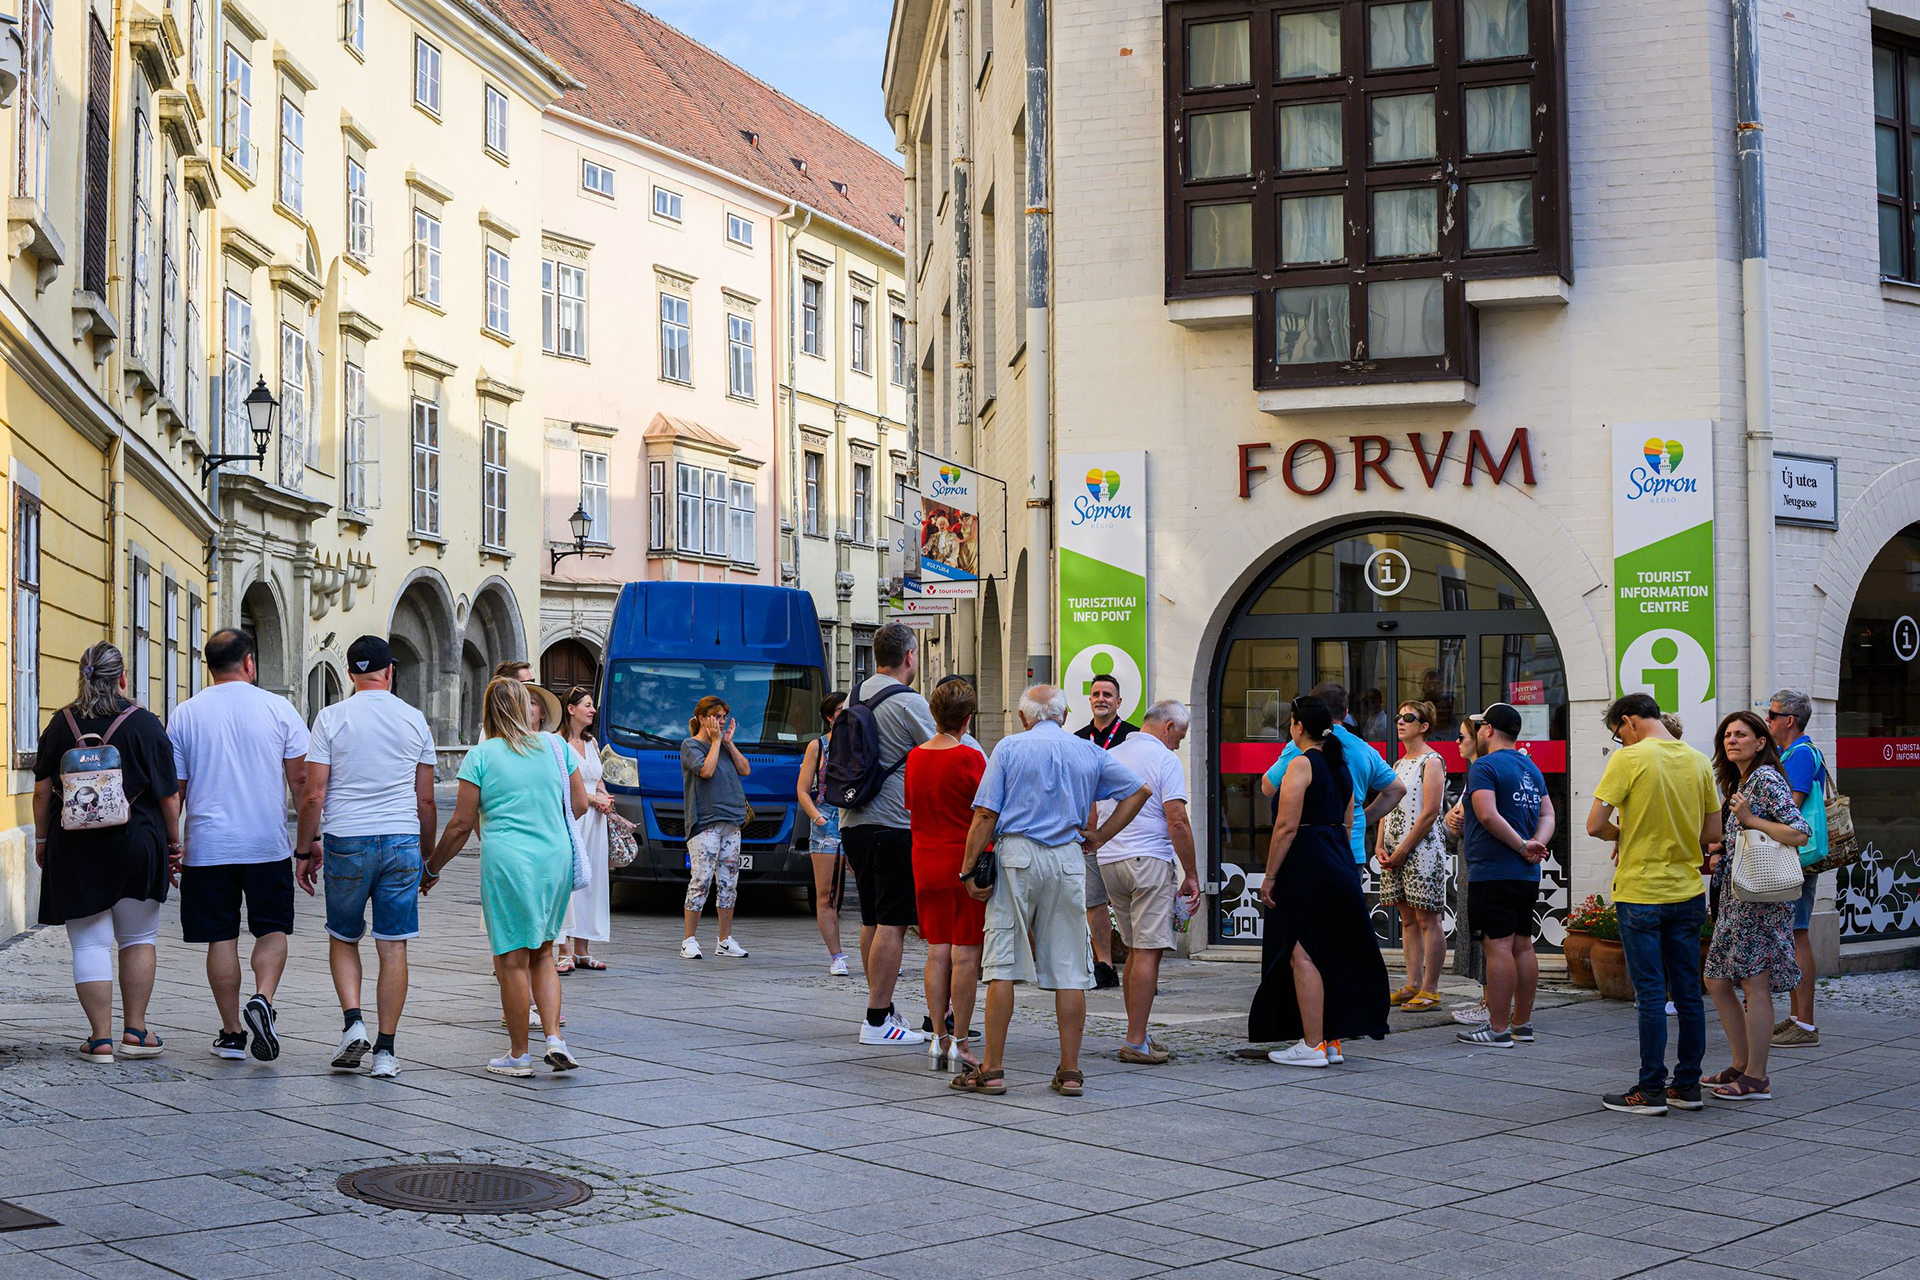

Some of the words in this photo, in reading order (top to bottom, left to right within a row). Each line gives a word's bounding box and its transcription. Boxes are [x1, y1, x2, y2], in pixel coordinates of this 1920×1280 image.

[1238, 427, 1537, 498] FORVM
[1627, 466, 1697, 500] Sopron
[1781, 467, 1793, 489] Új
[1796, 473, 1817, 488] utca
[930, 480, 967, 498] Sopron
[1783, 494, 1817, 510] Neugasse
[1071, 495, 1132, 526] Sopron
[1637, 570, 1691, 583] TOURIST
[1620, 585, 1709, 599] INFORMATION
[1068, 596, 1136, 609] TURISZTIKAI
[1640, 601, 1689, 613] CENTRE
[1073, 611, 1099, 622] INFO
[1101, 610, 1131, 622] PONT
